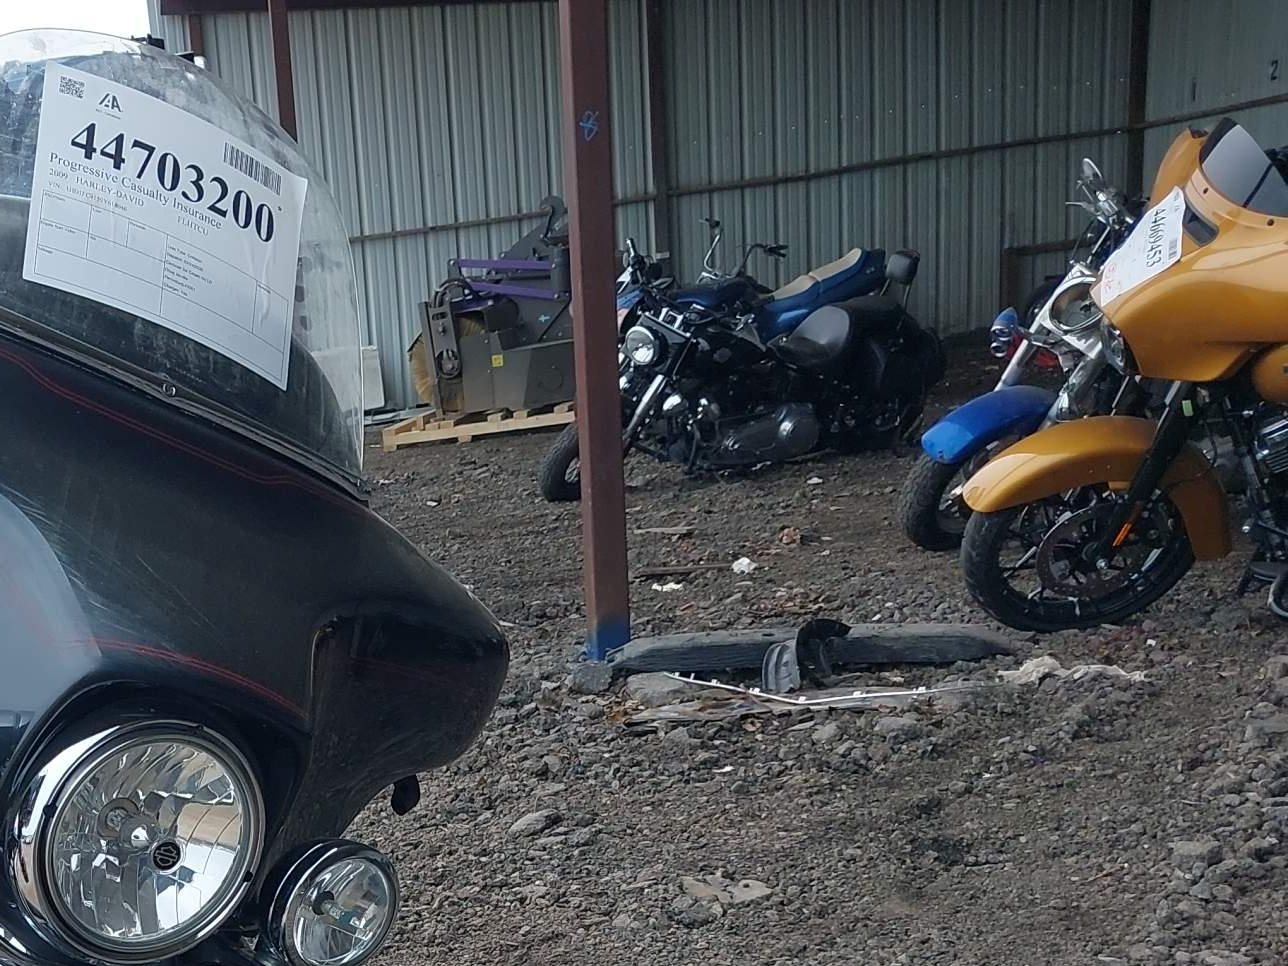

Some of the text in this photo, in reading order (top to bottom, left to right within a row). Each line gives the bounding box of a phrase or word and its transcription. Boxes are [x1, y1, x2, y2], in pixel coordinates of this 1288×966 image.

[1270, 60, 1279, 81] 2
[49, 152, 119, 183] Progressive
[121, 176, 170, 206] Casualty
[172, 197, 222, 230] Insurance
[70, 122, 275, 243] 44703200
[76, 176, 144, 207] HARLEY-DAVID
